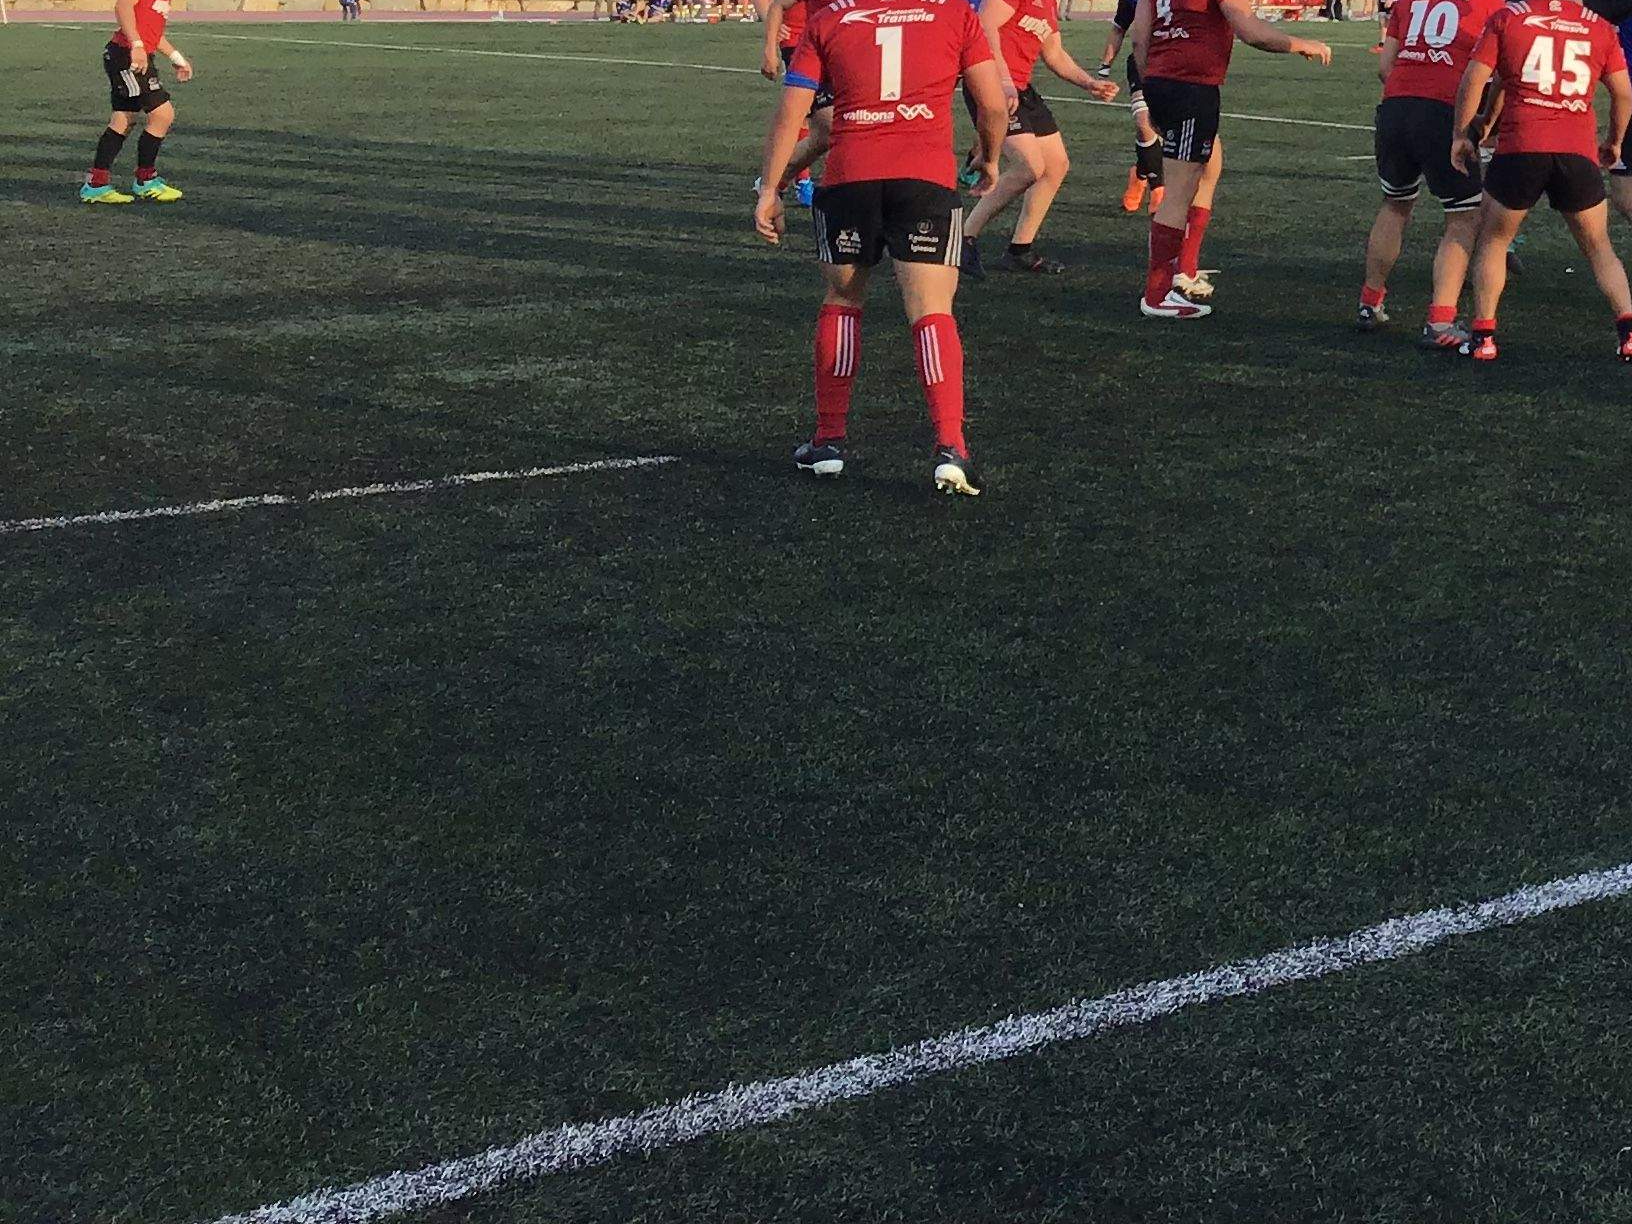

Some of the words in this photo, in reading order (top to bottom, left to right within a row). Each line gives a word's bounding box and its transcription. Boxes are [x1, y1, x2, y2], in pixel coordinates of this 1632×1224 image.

[876, 11, 935, 24] Transvia
[1404, 0, 1459, 48] 10
[875, 25, 903, 101] 1
[1520, 35, 1592, 96] 45
[843, 109, 895, 121] vallbona
